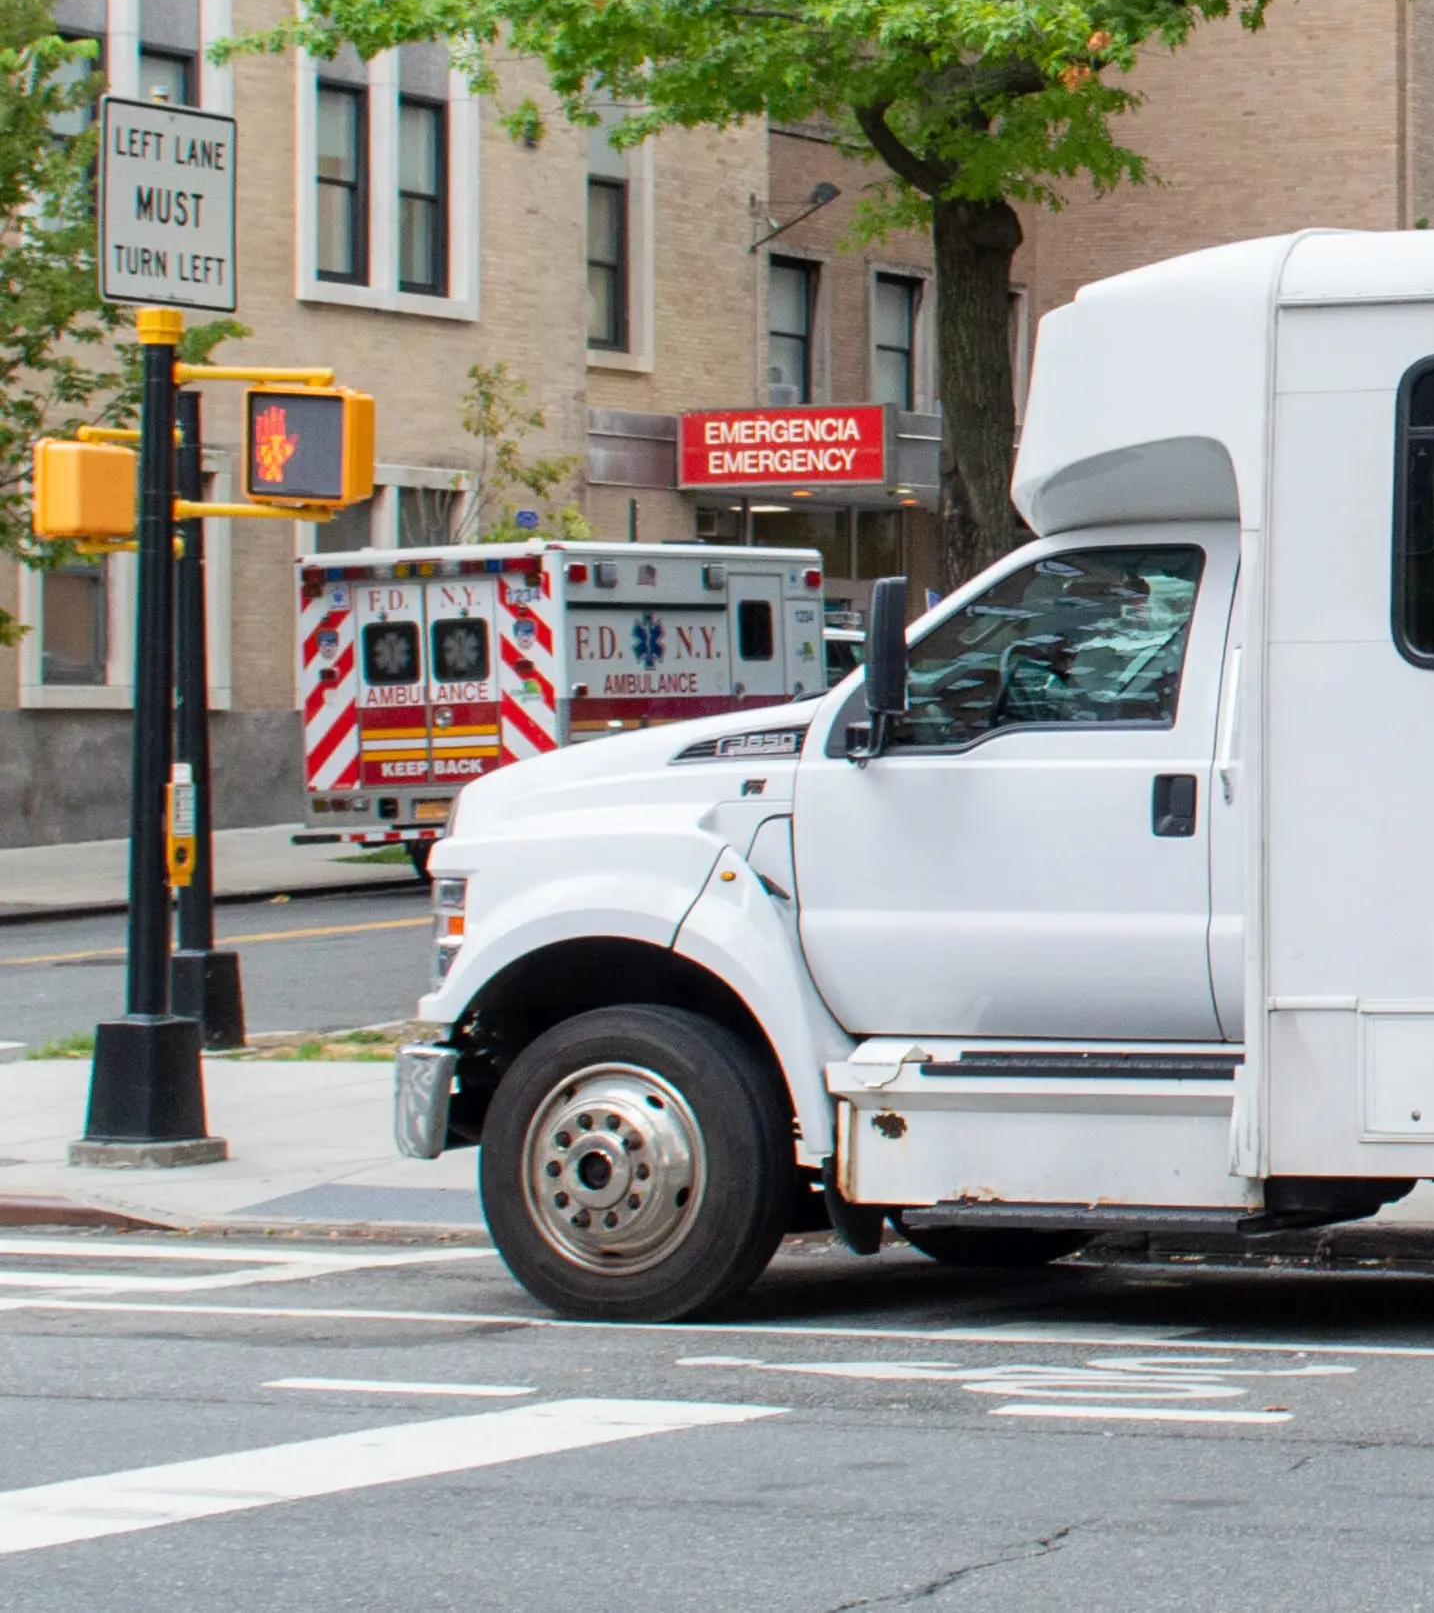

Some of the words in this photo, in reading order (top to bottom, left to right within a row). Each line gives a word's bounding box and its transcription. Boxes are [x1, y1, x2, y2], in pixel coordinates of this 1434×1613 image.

[115, 126, 164, 160] LEFT
[175, 136, 226, 171] LANE
[135, 185, 204, 228] MUST
[114, 244, 168, 279] TURN
[178, 253, 226, 285] LEFT
[704, 418, 861, 445] EMERGENCIA
[708, 448, 856, 474] EMERGENCY
[368, 589, 410, 611] F.D.
[440, 586, 482, 608] N.Y.
[505, 587, 541, 604] 1234
[573, 625, 623, 660] F.D.
[675, 626, 722, 660] N.Y.
[366, 682, 489, 706] AMBULANCE
[604, 672, 699, 694] AMBULANCE
[381, 760, 429, 777] KEEP
[433, 758, 484, 776] BACK
